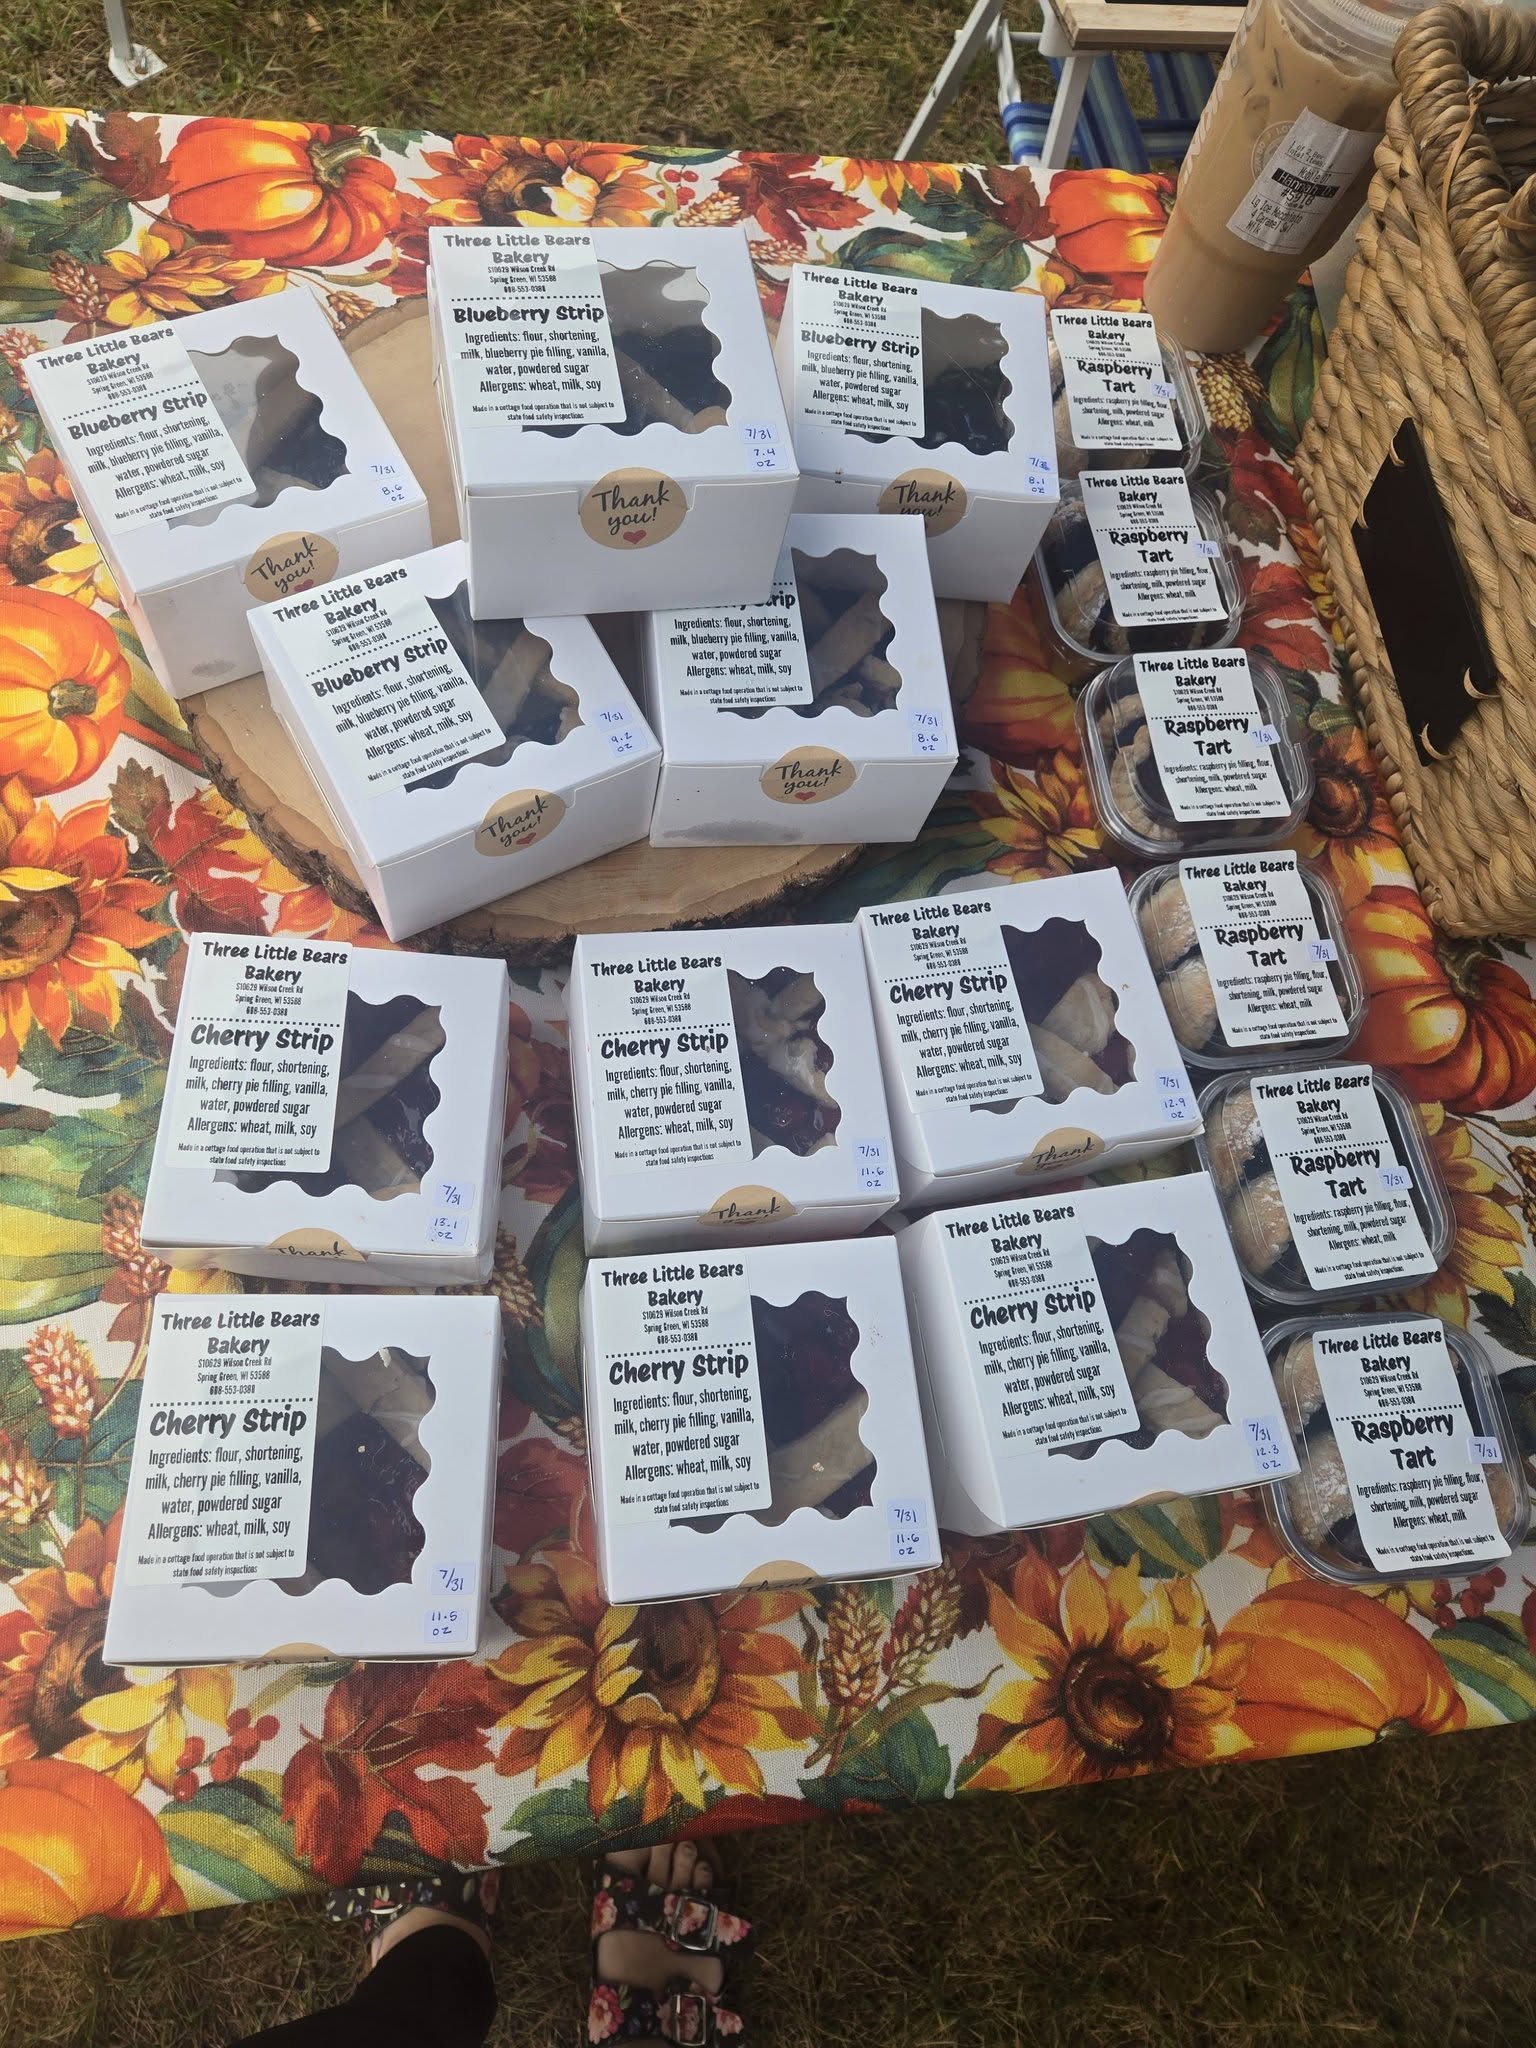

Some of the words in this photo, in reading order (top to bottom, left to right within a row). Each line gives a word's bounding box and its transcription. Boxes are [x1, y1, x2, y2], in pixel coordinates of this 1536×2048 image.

[1278, 171, 1319, 195] Hannah
[1260, 199, 1273, 211] Ice
[1280, 188, 1315, 206] #5918
[443, 234, 492, 247] Three
[497, 234, 540, 247] Little
[544, 235, 590, 246] Bears
[492, 251, 550, 265] Bakery
[453, 306, 550, 324] Blueberry
[556, 303, 604, 323] Strip
[1056, 315, 1088, 325] Three
[1091, 316, 1119, 327] Little
[1122, 318, 1152, 328] Bears
[801, 330, 877, 353] Blueberry
[881, 340, 920, 358] Strip
[1088, 330, 1125, 342] Bakery
[36, 352, 83, 369] Three
[86, 339, 128, 357] Little
[129, 328, 174, 345] Bears
[86, 353, 140, 375] Bakery
[1076, 360, 1152, 379] Raspberry
[1102, 379, 1136, 393] Tart
[67, 405, 157, 440] Blueberry
[162, 387, 209, 413] Strip
[745, 428, 772, 440] 7/31
[753, 448, 775, 457] 7.4
[370, 463, 396, 475] 7/31
[592, 480, 670, 513] Thank
[893, 480, 957, 503] Thank
[608, 507, 658, 535] you!
[1108, 530, 1188, 546] Raspberry
[250, 536, 319, 581] Thank
[1137, 549, 1174, 563] Tart
[275, 559, 316, 592] you!
[272, 600, 320, 622] Three
[321, 585, 363, 606] Little
[363, 568, 408, 590] Bears
[323, 598, 377, 625] Bakery
[674, 618, 722, 632] Ingredients:
[724, 617, 745, 629] flour,
[747, 616, 791, 628] shortening,
[670, 634, 690, 646] milk,
[691, 633, 728, 646] blueberry
[730, 632, 742, 646] pie
[744, 632, 769, 645] filling,
[770, 631, 799, 642] vanilla,
[311, 655, 400, 697] Blueberry
[404, 639, 448, 663] Strip
[915, 714, 938, 727] 7/31
[1163, 718, 1249, 737] Raspberry
[917, 733, 939, 743] 8.6
[1252, 731, 1272, 742] 7/31
[1193, 739, 1232, 756] Tart
[775, 760, 842, 779] Thank
[784, 777, 828, 795] you!
[480, 794, 549, 838] Thank
[500, 816, 543, 848] you!
[1214, 924, 1303, 947] Raspberry
[1246, 948, 1287, 967] Tart
[1312, 945, 1330, 959] 7/31
[890, 981, 953, 1004] Cherry
[959, 974, 1007, 994] Strip
[191, 1024, 270, 1052] Cherry
[275, 1027, 334, 1054] Strip
[601, 1037, 671, 1059] Cherry
[677, 1033, 729, 1054] Strip
[1164, 1098, 1186, 1108] 12.9
[858, 1146, 880, 1157] 7/31
[861, 1167, 884, 1176] 11.6
[1289, 1149, 1380, 1176] Raspberry
[1324, 1177, 1367, 1199] Tart
[1382, 1173, 1404, 1186] 7/31
[443, 1184, 461, 1205] 7/31
[712, 1196, 781, 1219] Thank
[970, 1300, 1038, 1329] Cherry
[1044, 1290, 1096, 1315] Strip
[161, 1313, 212, 1330] Three
[218, 1311, 265, 1329] Little
[270, 1311, 320, 1327] Bears
[207, 1336, 270, 1357] Bakery
[1318, 1338, 1359, 1355] Three
[1363, 1333, 1399, 1350] Little
[1402, 1331, 1442, 1346] Bears
[198, 1358, 222, 1368] S10629
[223, 1358, 244, 1367] Wilson
[245, 1357, 262, 1367] Creek
[609, 1359, 685, 1385] Cherry
[692, 1353, 749, 1378] Strip
[1360, 1356, 1410, 1373] Bakery
[197, 1372, 218, 1384] Spring
[219, 1372, 238, 1381] Green,
[250, 1370, 270, 1380] 53588
[150, 1409, 236, 1439] Cherry
[242, 1404, 307, 1437] Strip
[1351, 1414, 1453, 1443] Raspberry
[1248, 1422, 1271, 1442] 7/31
[149, 1448, 212, 1468] Ingredients:
[215, 1447, 242, 1464] flour,
[245, 1445, 303, 1463] shortening,
[1256, 1445, 1279, 1456] 12.3
[1390, 1446, 1437, 1470] Tart
[1474, 1444, 1498, 1458] 7/31
[145, 1473, 170, 1491] milk,
[173, 1472, 208, 1492] cherry
[210, 1471, 226, 1491] pie
[229, 1470, 261, 1489] filling,
[265, 1468, 302, 1486] vanilla,
[1356, 1482, 1398, 1498] Ingredients:
[1399, 1478, 1431, 1493] raspberry
[1432, 1478, 1443, 1490] pie
[1443, 1474, 1466, 1487] filling,
[1465, 1472, 1484, 1483] flour,
[162, 1498, 194, 1515] water,
[197, 1494, 249, 1516] powdered
[252, 1496, 282, 1513] sugar
[1370, 1498, 1409, 1513] shortening,
[1409, 1496, 1426, 1508] milk,
[1426, 1491, 1459, 1509] powdered
[1459, 1492, 1478, 1504] sugar
[894, 1508, 917, 1523] 7/31
[1393, 1516, 1427, 1529] Allergens:
[1427, 1511, 1452, 1524] wheat,
[1451, 1509, 1467, 1521] milk
[148, 1523, 203, 1542] Allergens:
[206, 1520, 241, 1538] wheat,
[244, 1518, 269, 1536] milk,
[272, 1521, 291, 1537] soy
[896, 1533, 920, 1544] 11.6
[439, 1568, 464, 1591] 7/31
[431, 1611, 457, 1621] 11.5
